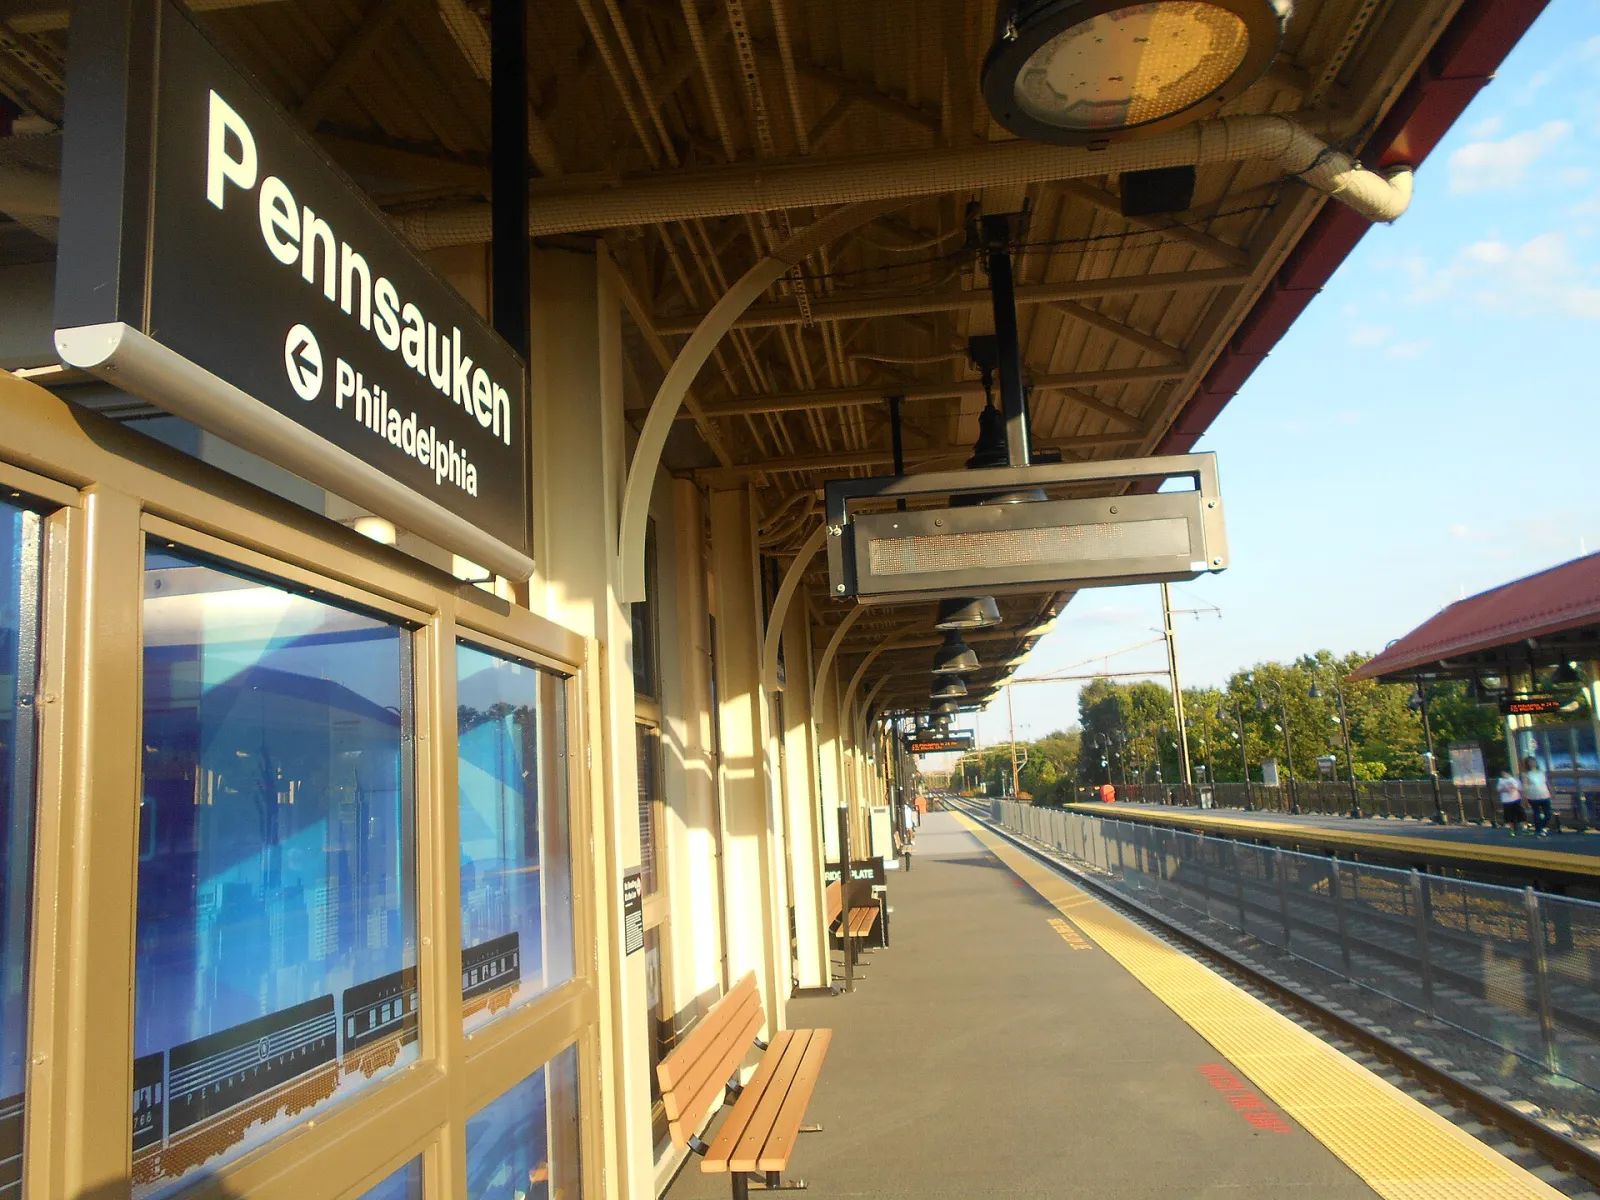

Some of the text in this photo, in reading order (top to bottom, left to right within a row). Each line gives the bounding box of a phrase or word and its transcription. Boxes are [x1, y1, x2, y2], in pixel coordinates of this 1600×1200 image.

[207, 88, 511, 446] Pennsauken
[335, 357, 478, 497] Philadelphia
[186, 1038, 327, 1106] PENNSYLVANIA
